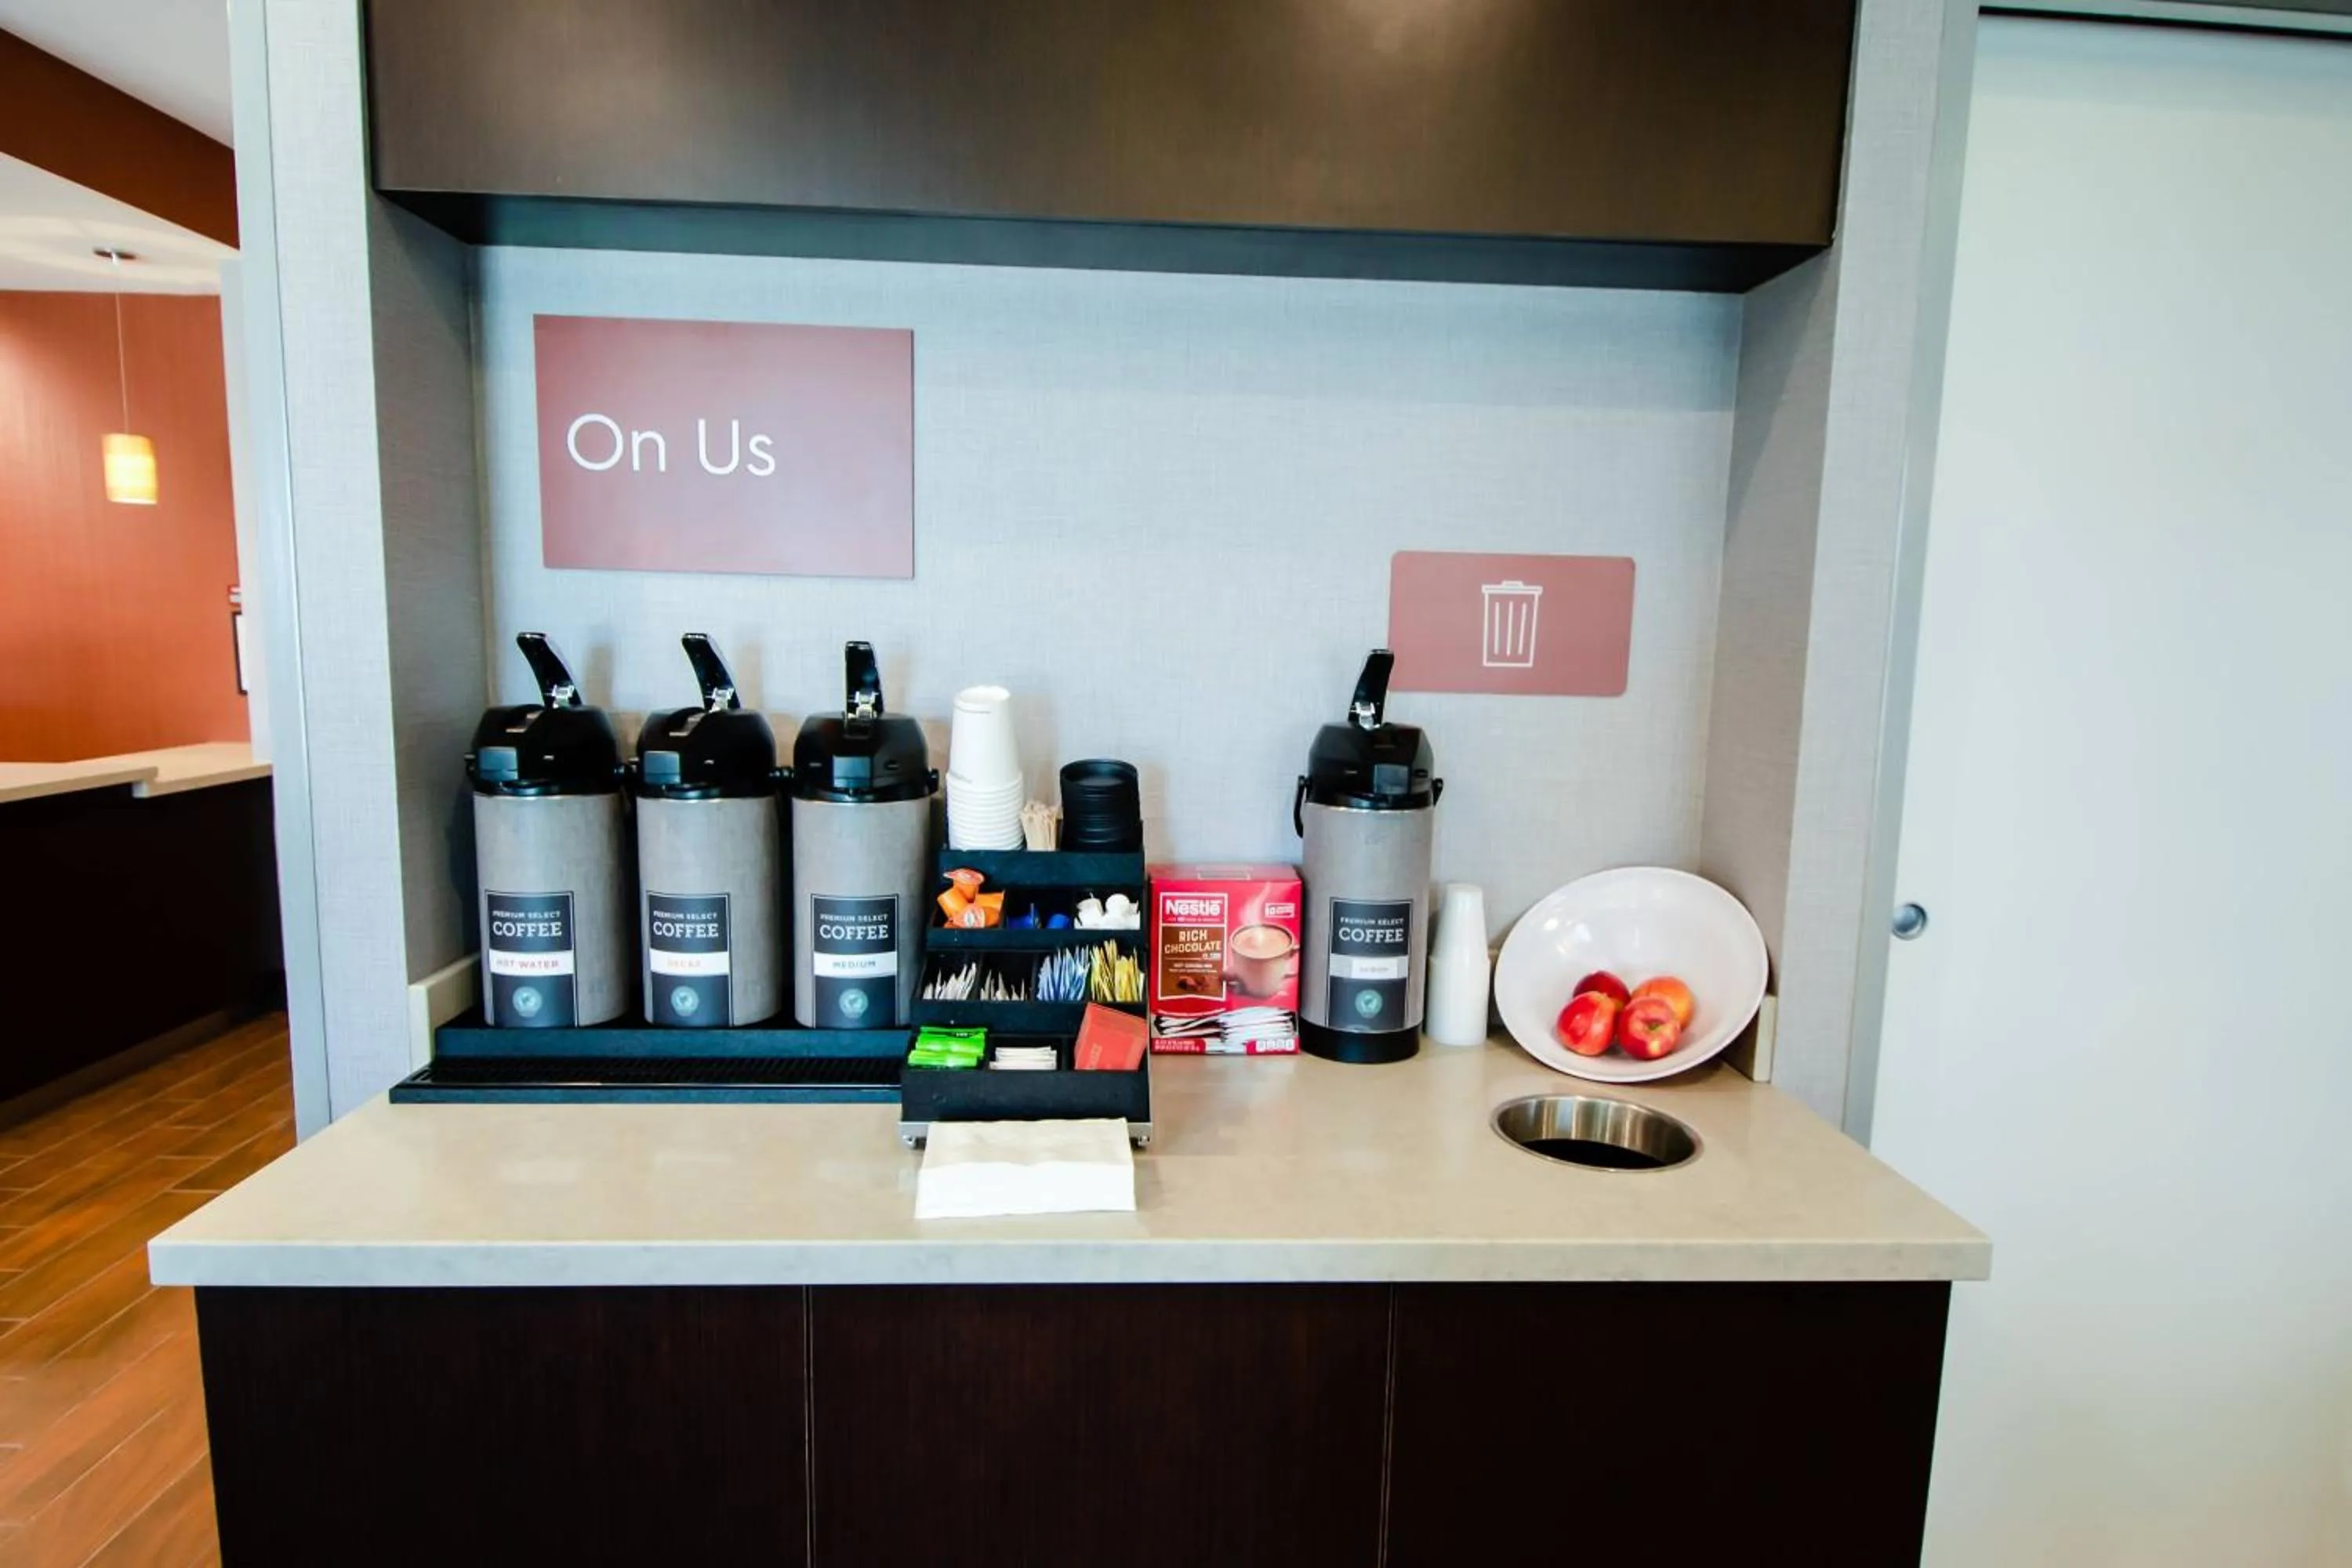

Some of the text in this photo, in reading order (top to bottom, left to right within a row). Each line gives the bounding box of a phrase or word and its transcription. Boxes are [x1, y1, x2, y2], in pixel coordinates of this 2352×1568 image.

[567, 413, 776, 477] On Us
[528, 910, 561, 919] SELECT
[653, 910, 684, 920] PREMIUM
[492, 921, 562, 937] COFFEE
[653, 921, 719, 938] COFFEE
[819, 924, 888, 940] COFFEE
[1178, 929, 1207, 942] RICH
[1338, 927, 1404, 943] COFFEE
[1164, 941, 1221, 954] CHOCOLATE
[518, 960, 559, 968] WATER
